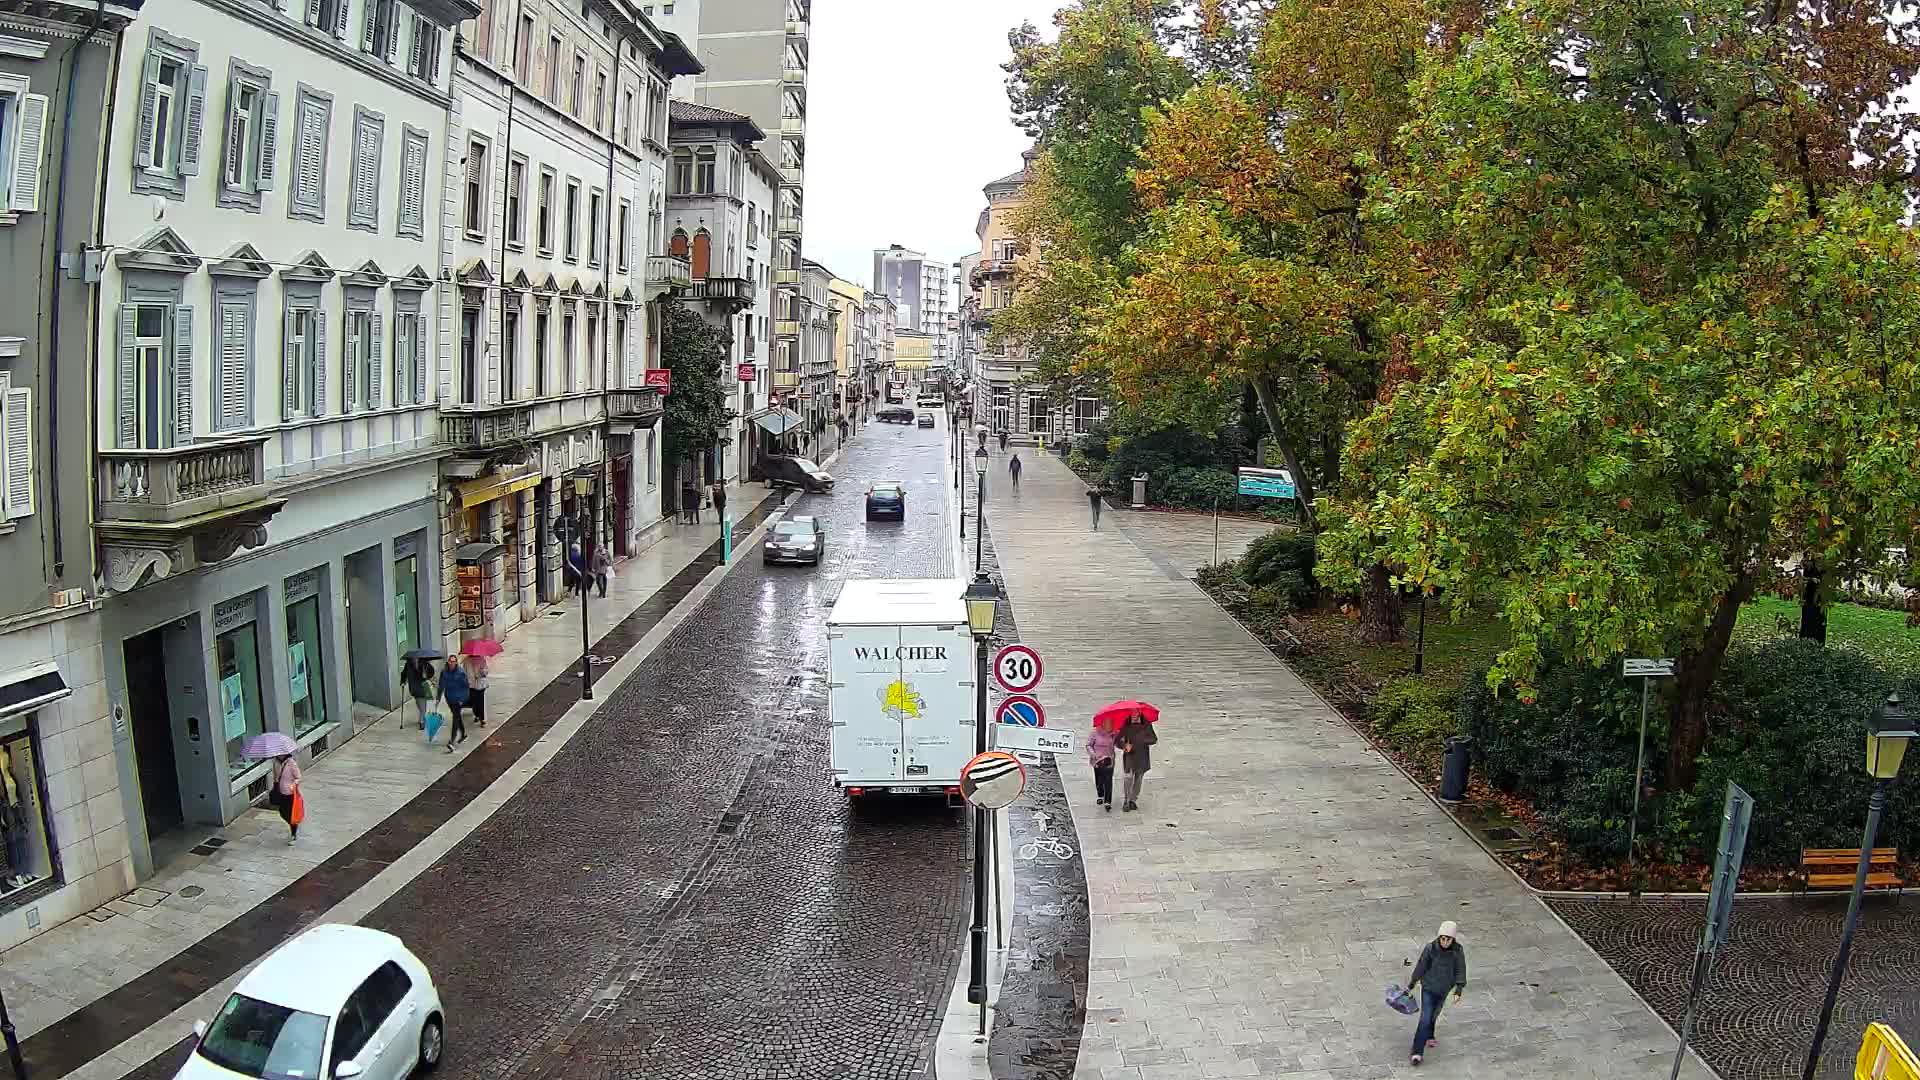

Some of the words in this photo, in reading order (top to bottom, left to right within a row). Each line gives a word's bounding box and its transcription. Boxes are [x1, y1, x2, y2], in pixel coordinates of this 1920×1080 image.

[854, 646, 948, 660] WALCHER
[1005, 657, 1033, 680] 30
[1037, 737, 1069, 749] Dante
